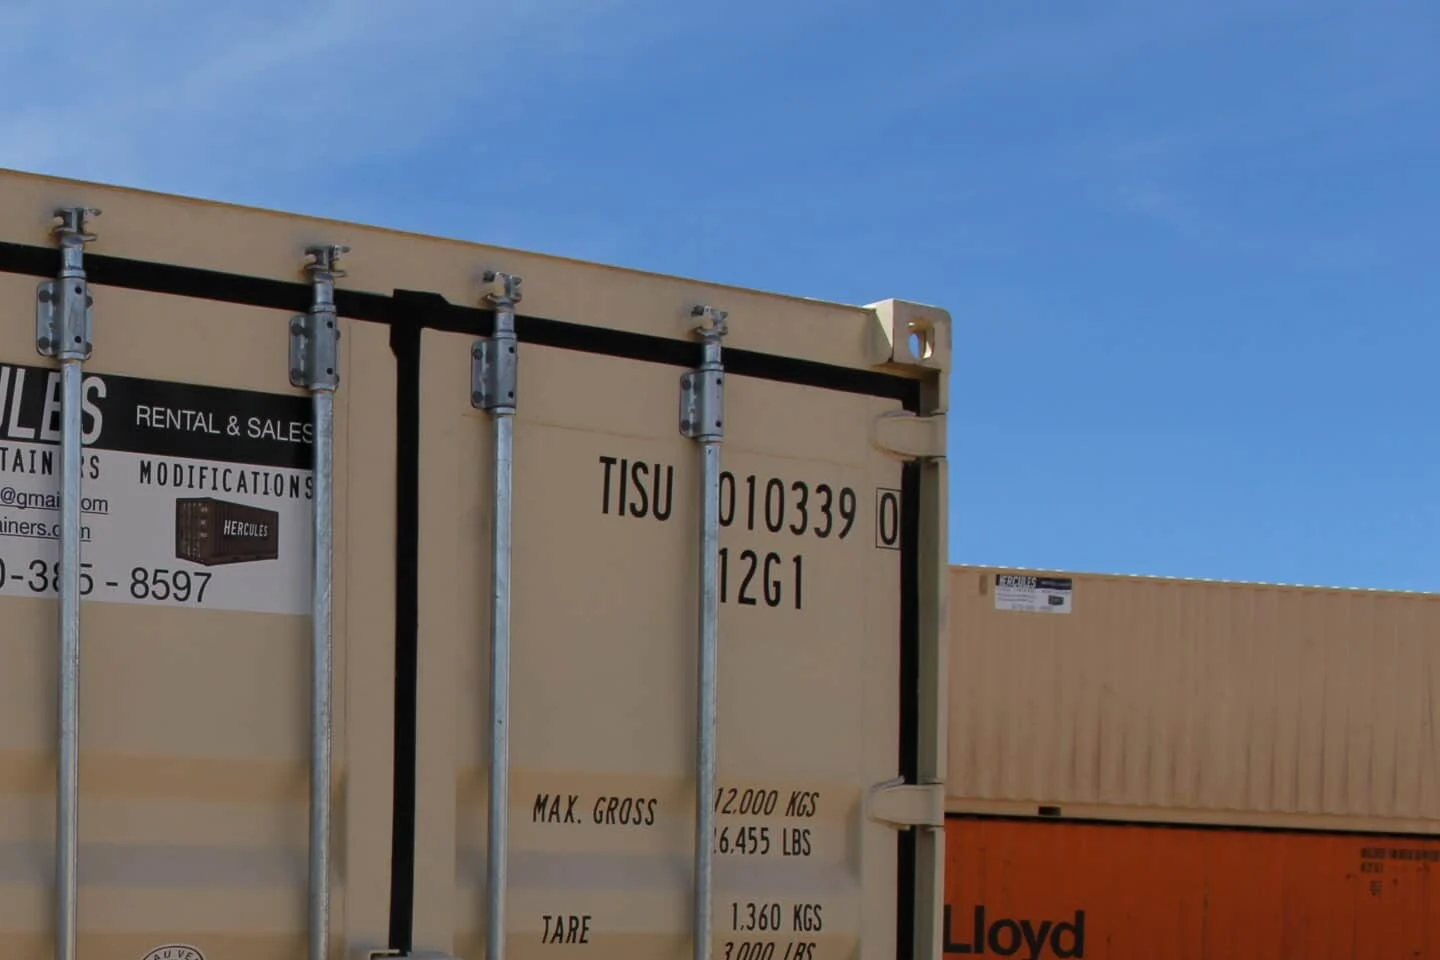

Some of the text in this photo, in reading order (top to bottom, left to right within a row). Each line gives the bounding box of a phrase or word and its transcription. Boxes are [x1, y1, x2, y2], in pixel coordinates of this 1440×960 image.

[136, 405, 313, 443] RENTAL & SALES
[140, 459, 313, 499] MODIFICATIONS
[599, 455, 899, 546] TISU 010339 0
[224, 519, 269, 537] HERCULES
[718, 547, 803, 609] 12G1
[532, 794, 658, 826] MAX. GROSS
[785, 791, 820, 818] KGS
[782, 827, 812, 856] LBS
[540, 915, 592, 944] TARE
[792, 903, 823, 931] KGS
